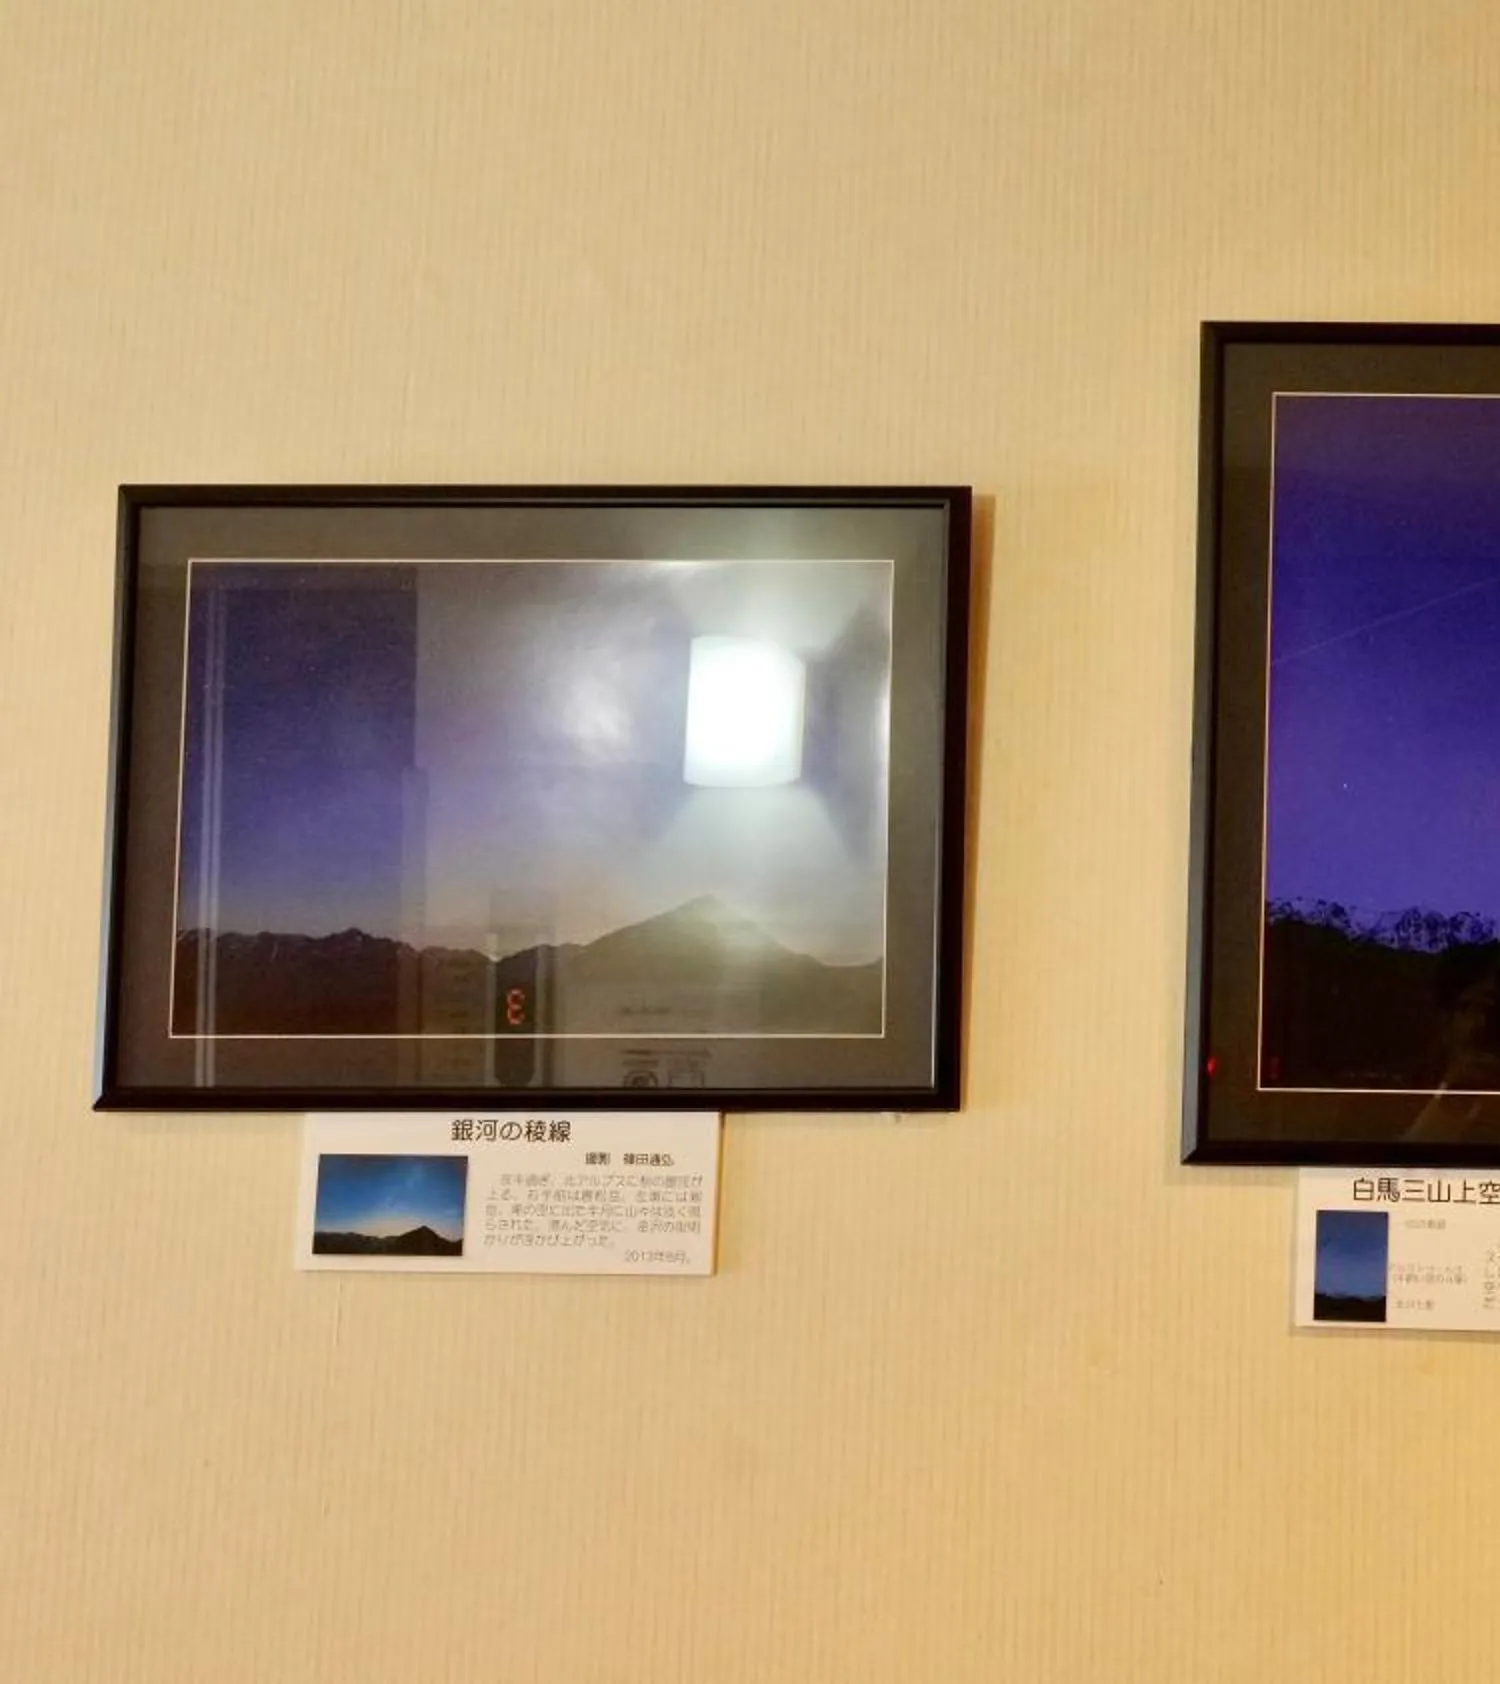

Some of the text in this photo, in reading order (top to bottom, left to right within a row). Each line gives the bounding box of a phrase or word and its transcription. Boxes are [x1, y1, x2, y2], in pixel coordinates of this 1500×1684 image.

[451, 1119, 571, 1143] 銀河の稜線
